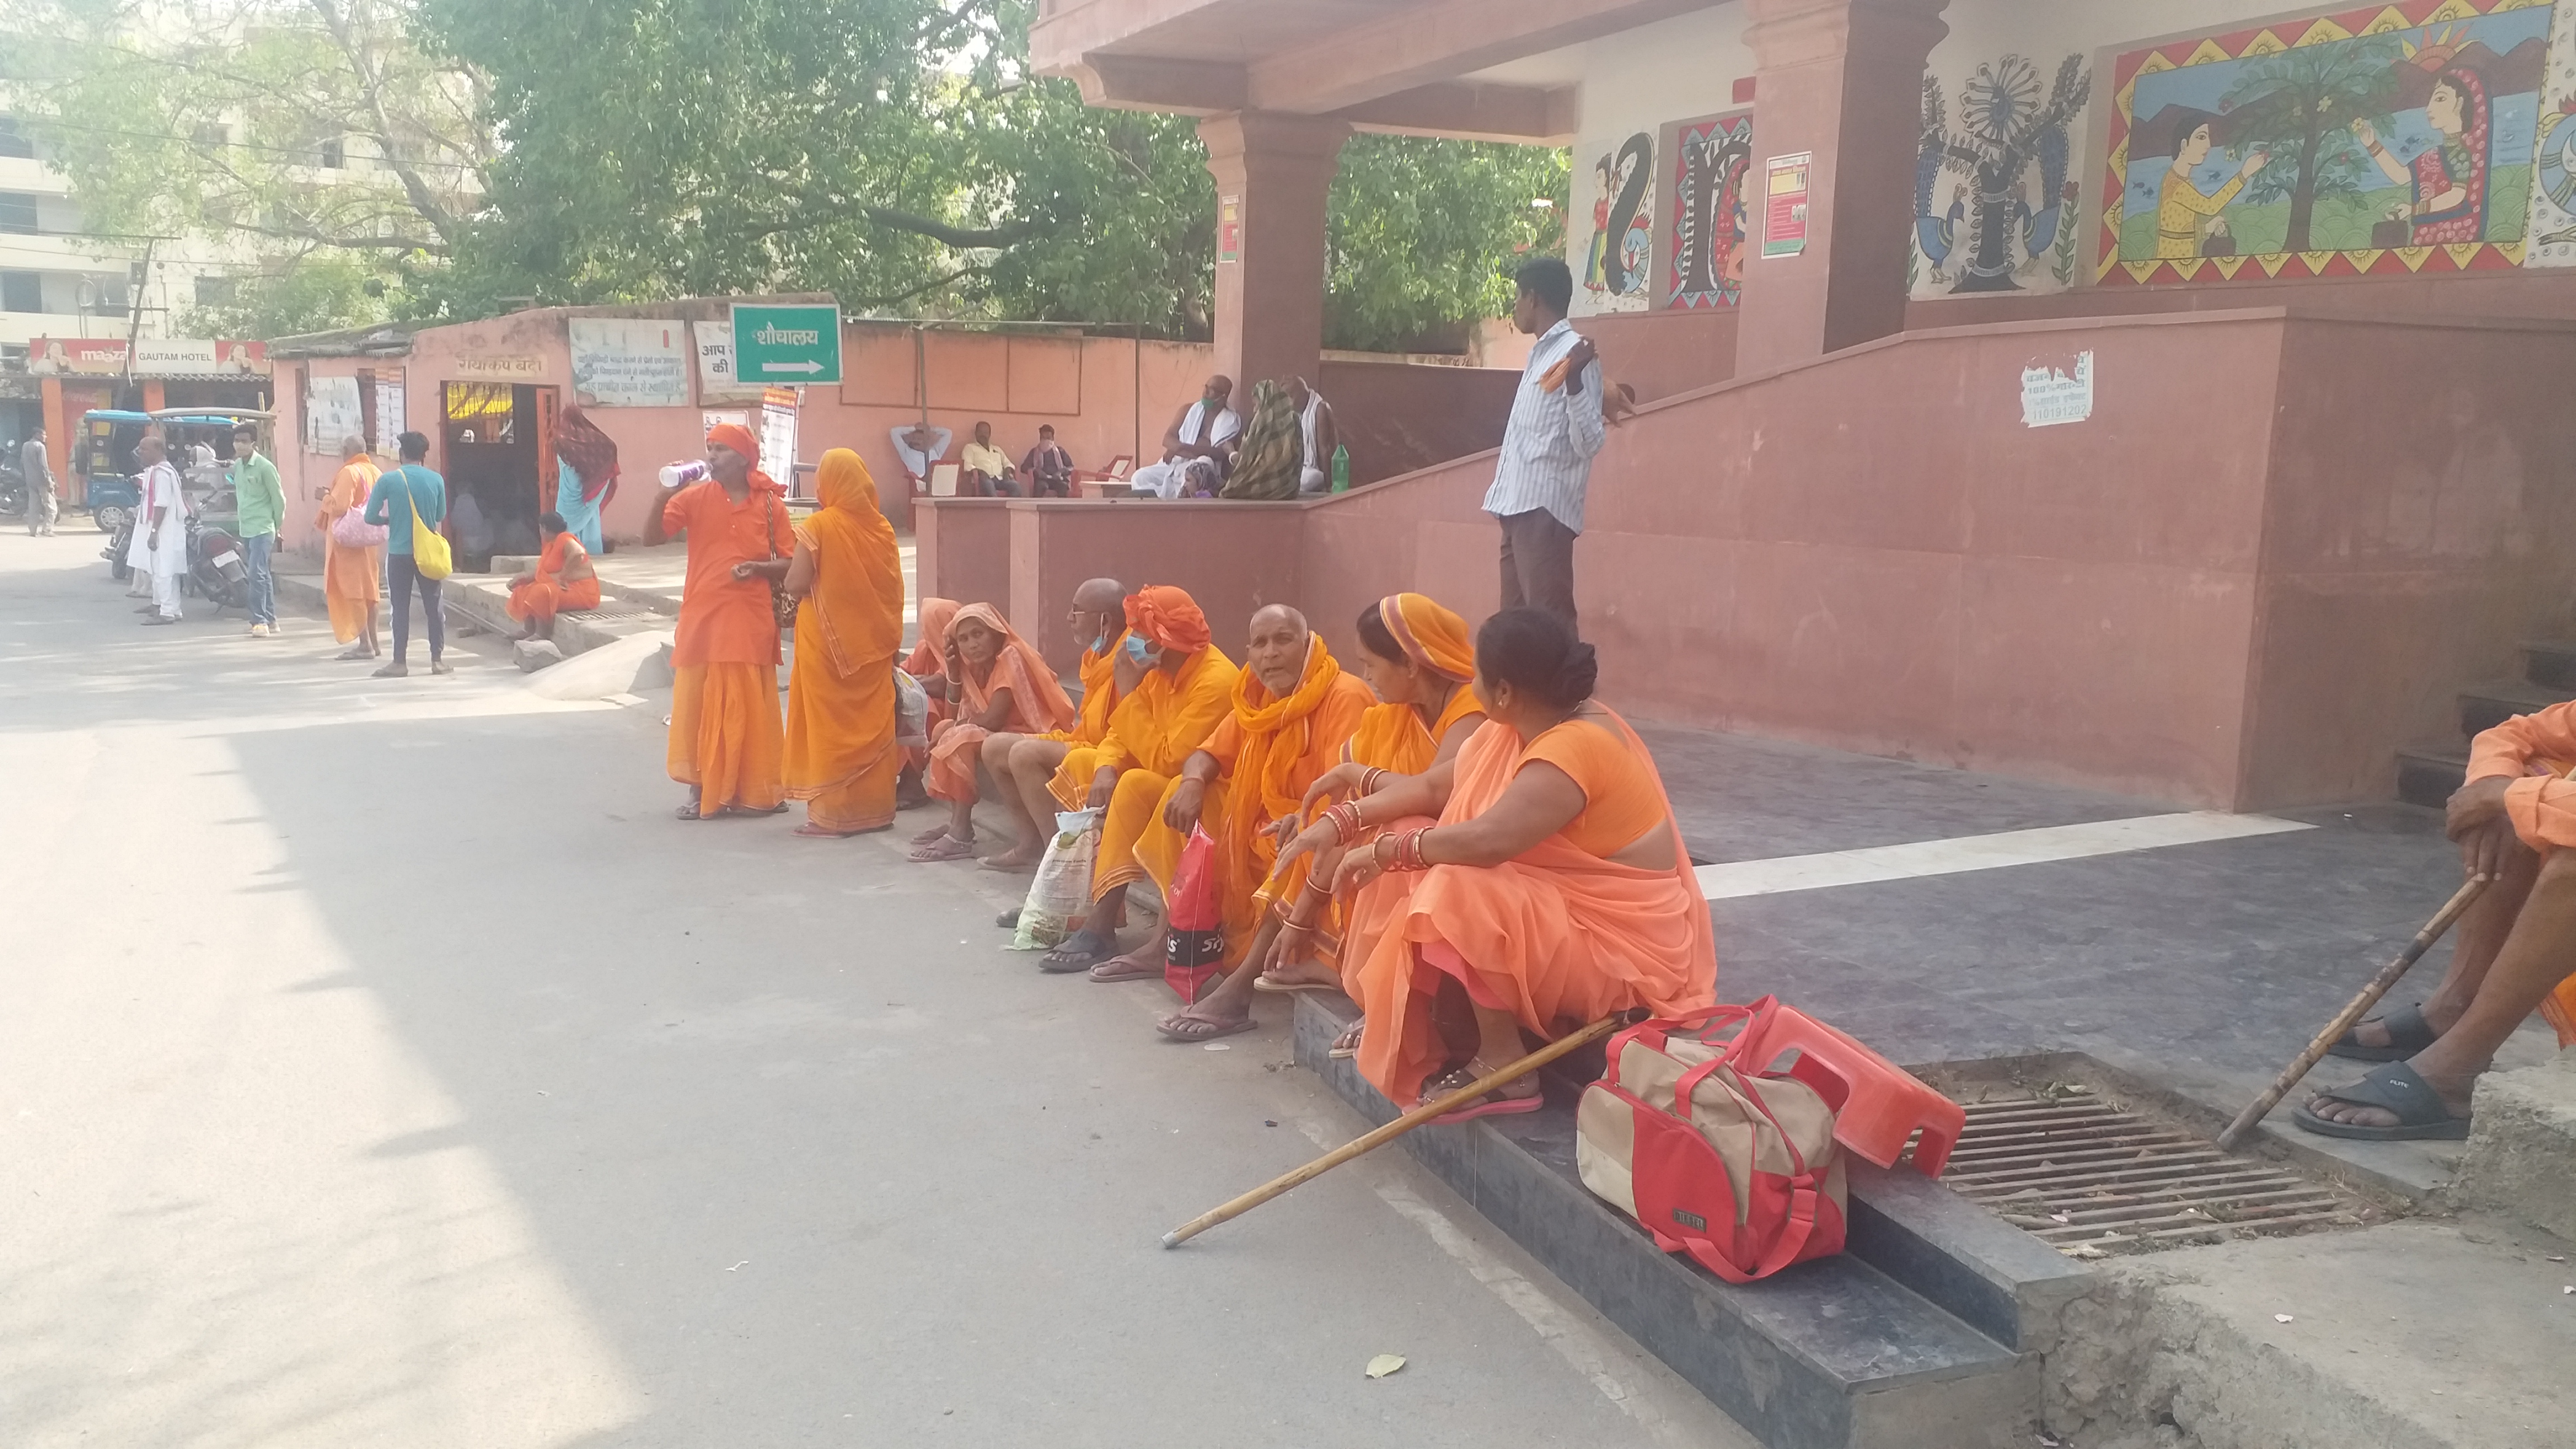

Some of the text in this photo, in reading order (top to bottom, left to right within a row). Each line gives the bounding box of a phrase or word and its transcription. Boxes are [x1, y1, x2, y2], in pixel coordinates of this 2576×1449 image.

[757, 321, 819, 345] शौचालय
[80, 350, 126, 363] maaza
[702, 345, 726, 356] आप
[712, 358, 728, 373] की
